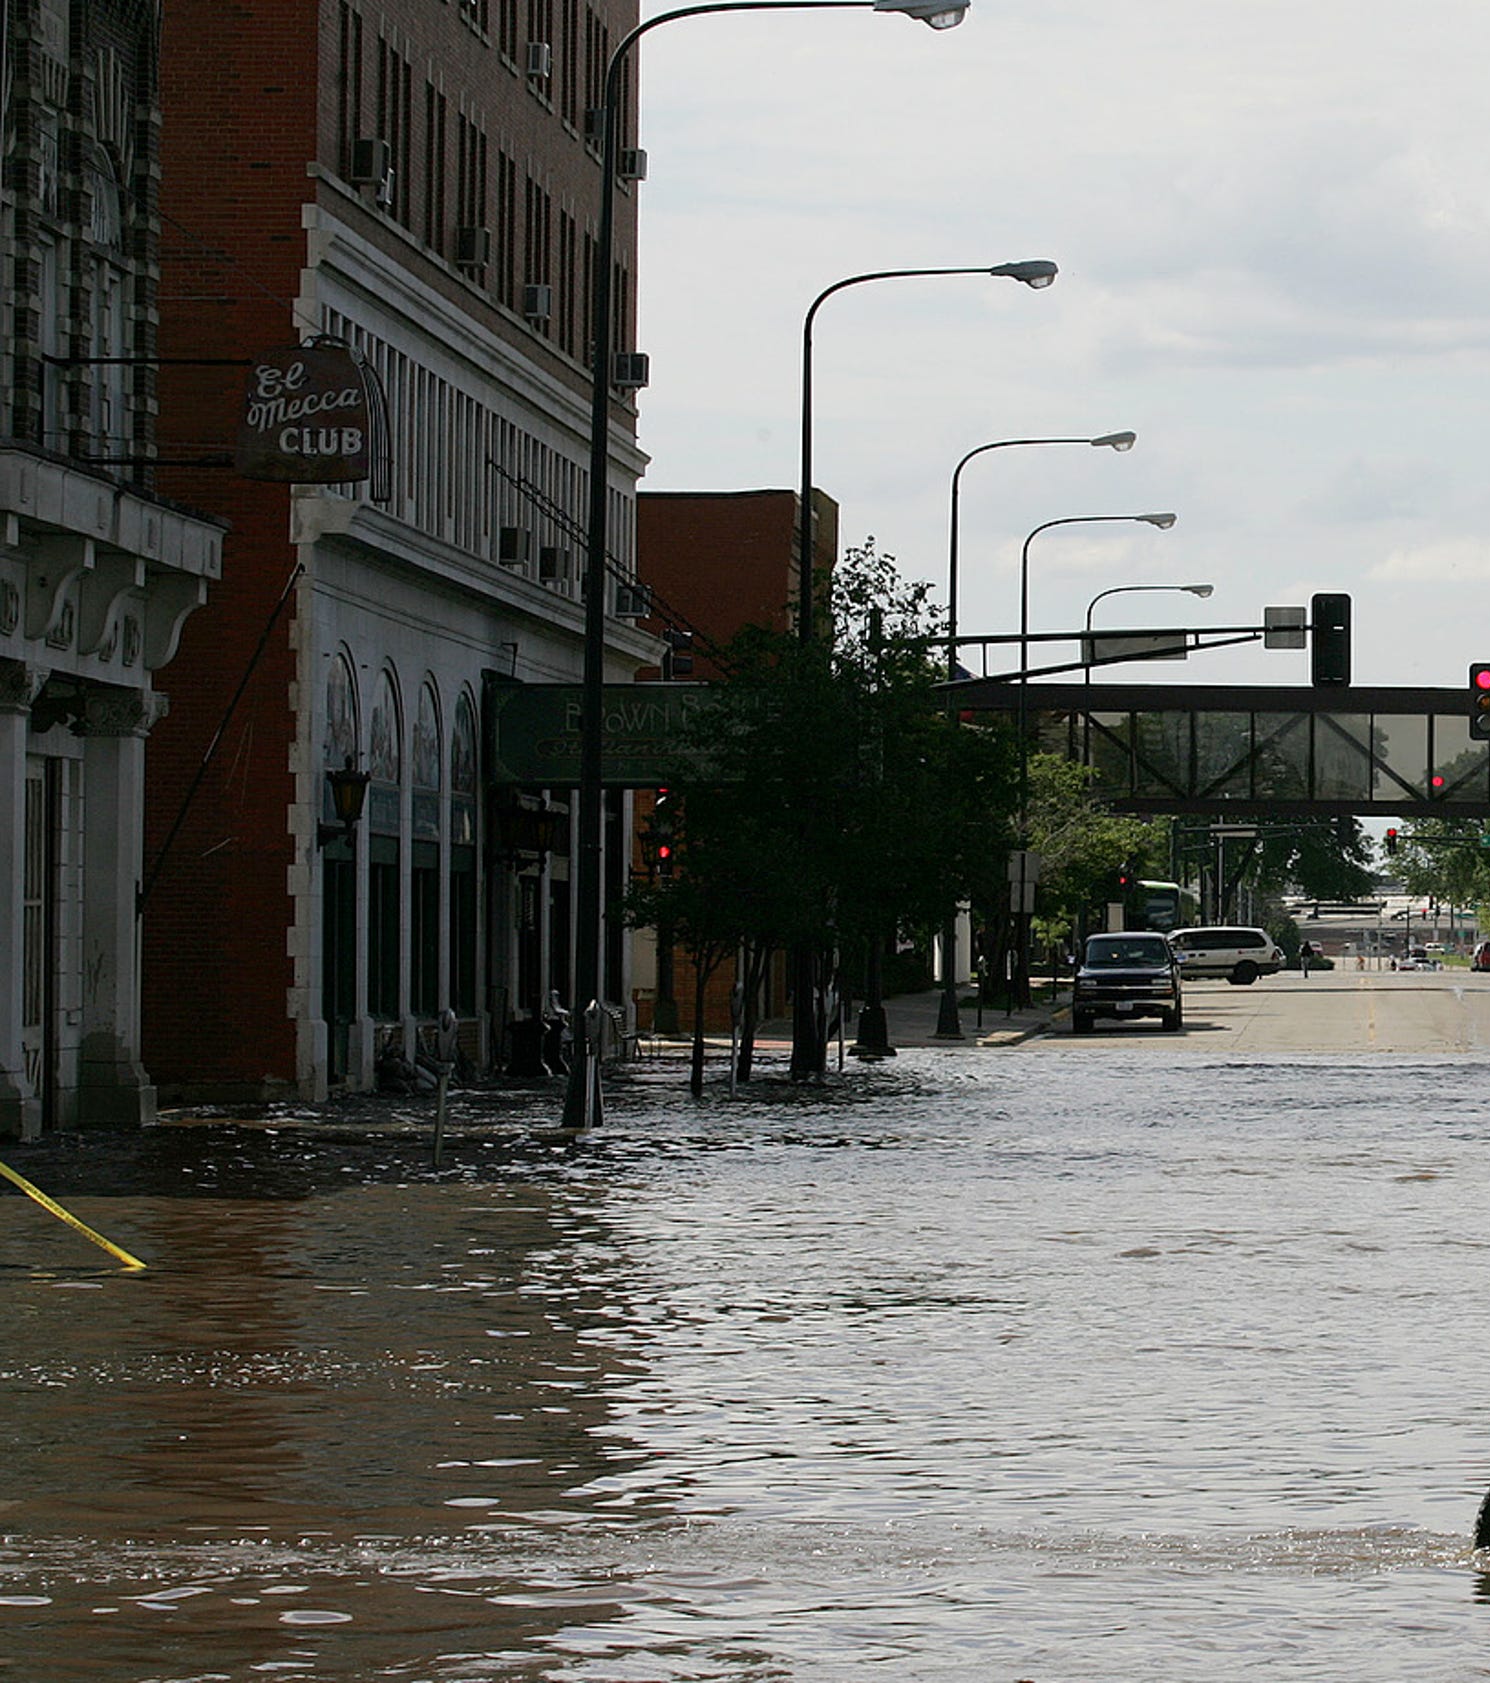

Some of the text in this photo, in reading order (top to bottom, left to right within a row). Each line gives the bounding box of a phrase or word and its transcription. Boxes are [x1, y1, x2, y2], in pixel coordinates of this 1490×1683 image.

[255, 361, 309, 398] El
[246, 388, 362, 434] Mecca
[278, 426, 363, 456] CLUB
[565, 702, 670, 735] BOWN
